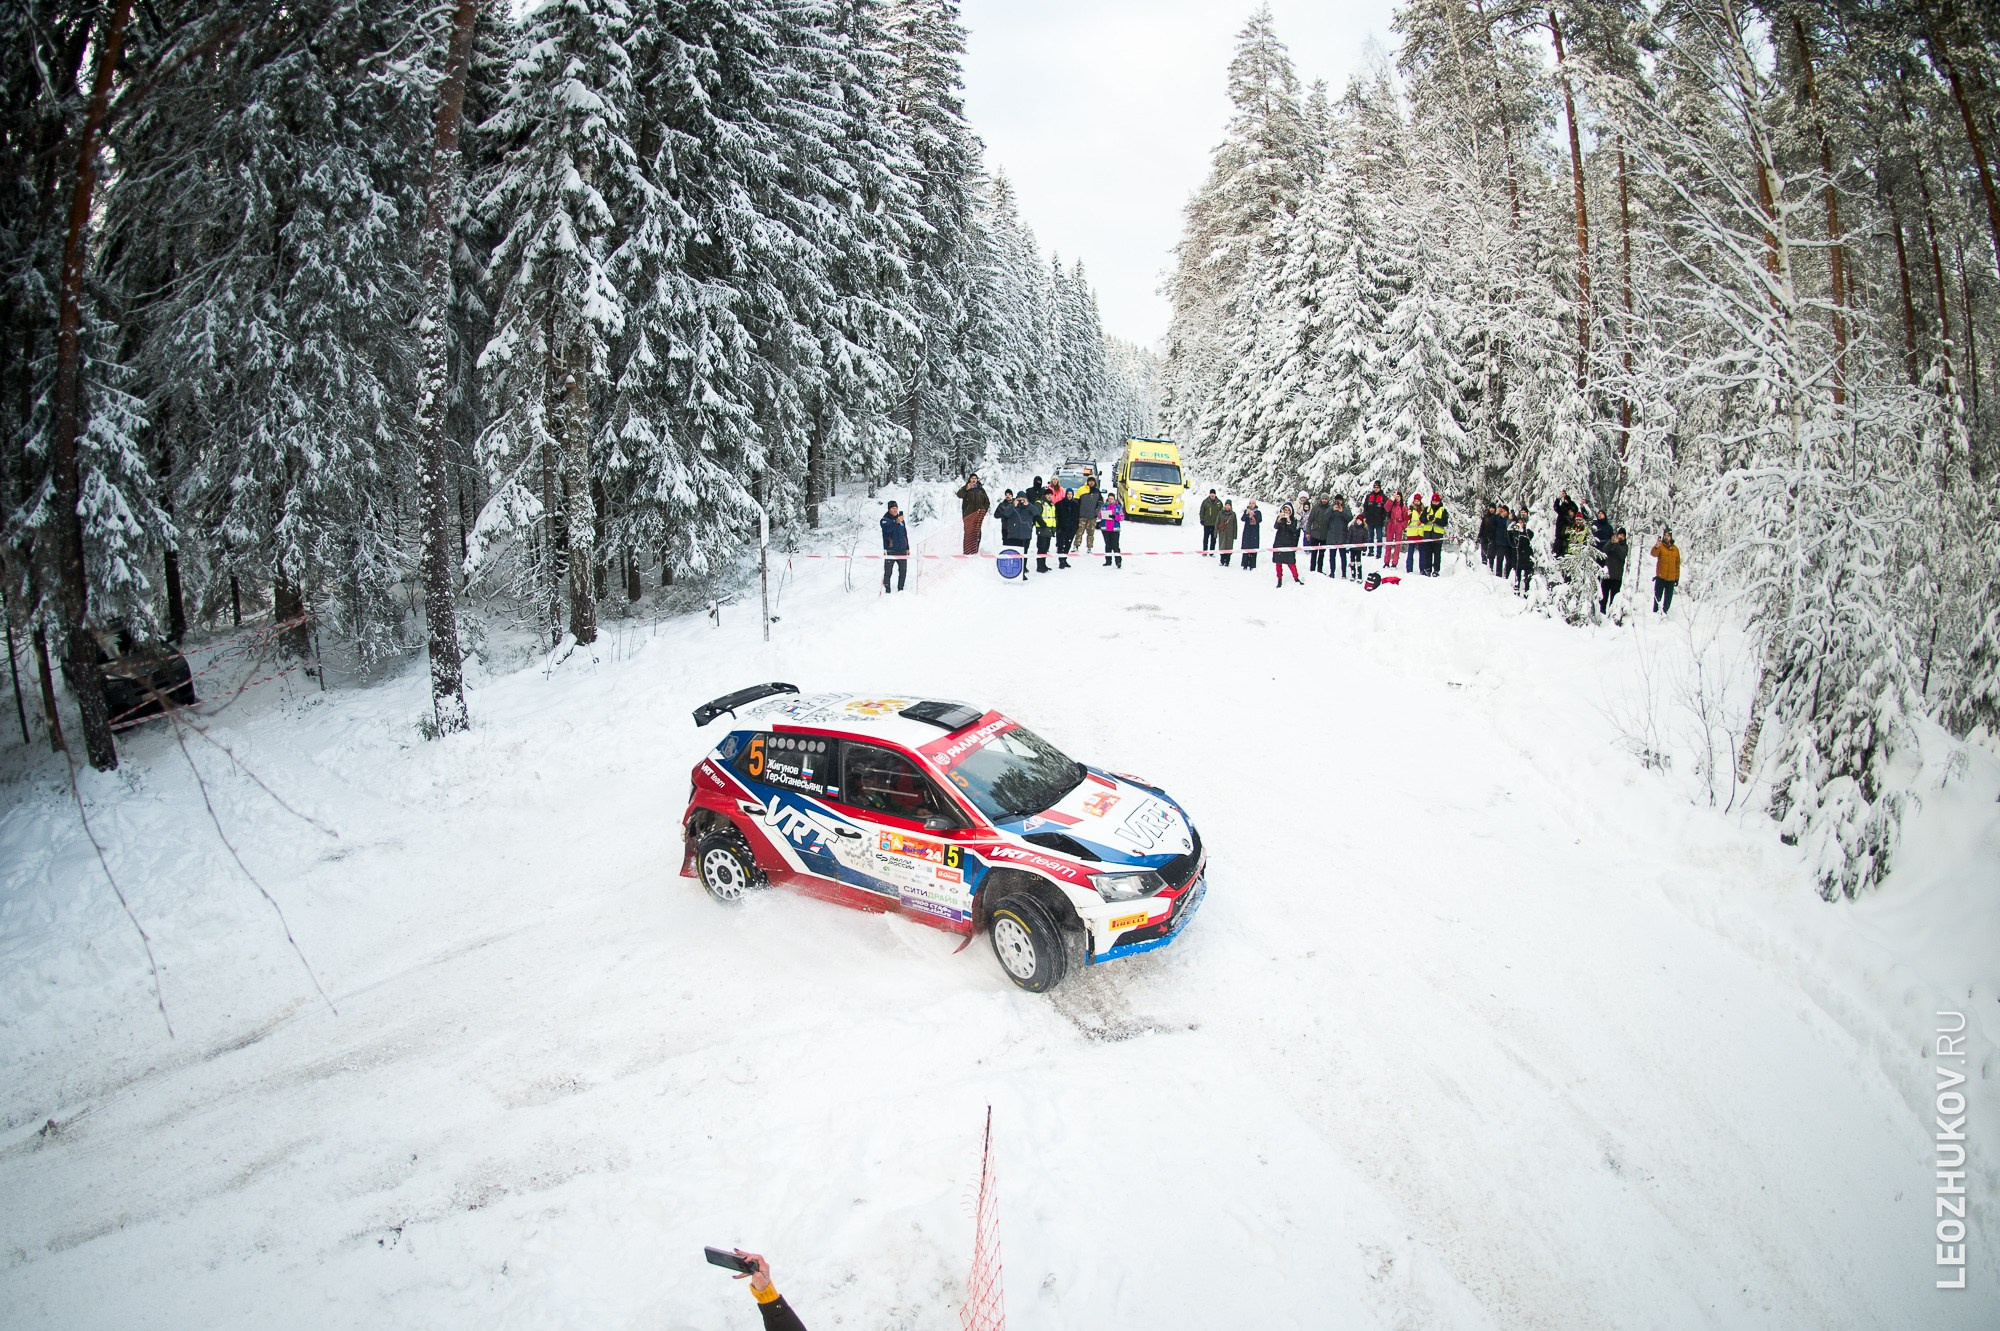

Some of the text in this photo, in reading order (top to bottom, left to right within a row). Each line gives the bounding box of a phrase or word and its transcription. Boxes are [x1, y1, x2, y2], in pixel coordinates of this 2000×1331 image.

[946, 734, 980, 757] РАЛЛИ
[976, 719, 1008, 738] РОССИИ
[749, 739, 764, 776] 5
[767, 759, 799, 775] Жигунов
[701, 763, 725, 788] VRT team
[766, 769, 823, 794] Тер-Оганесьянц
[949, 771, 969, 788] 5
[764, 795, 839, 854] VRT
[1114, 799, 1175, 849] VRT
[925, 848, 942, 862] 24
[947, 845, 959, 868] 5
[990, 846, 1077, 879] VRT team
[1111, 914, 1146, 928] PIRELLI
